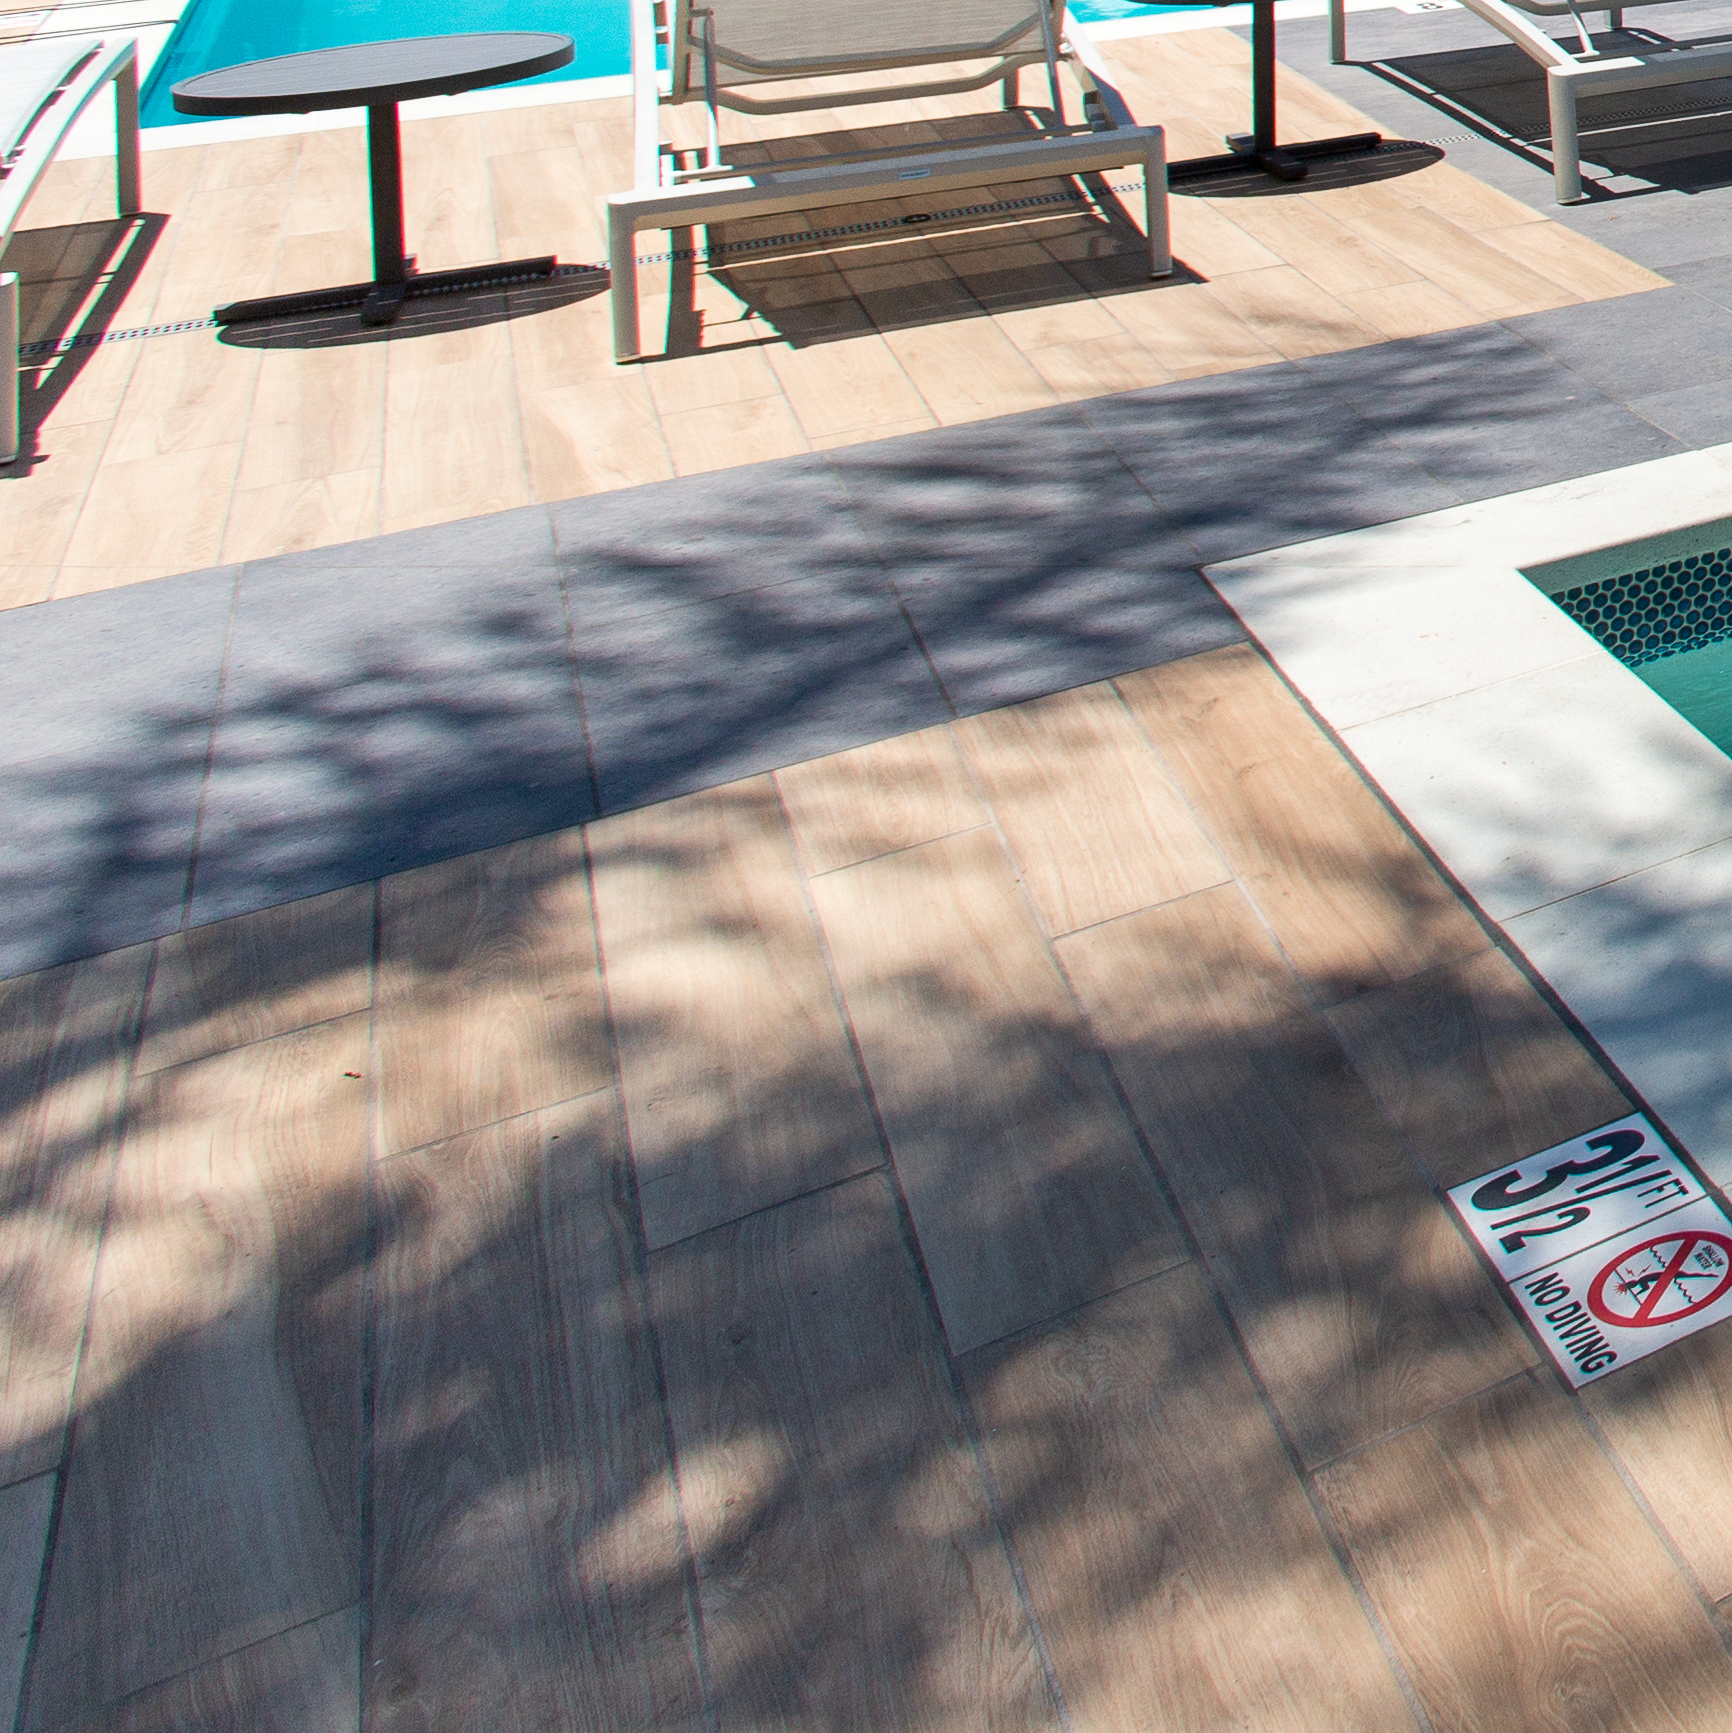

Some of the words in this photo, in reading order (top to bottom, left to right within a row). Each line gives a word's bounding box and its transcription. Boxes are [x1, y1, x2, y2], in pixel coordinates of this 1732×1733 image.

[1638, 1176, 1691, 1208] FT
[1524, 1272, 1571, 1306] NO
[1544, 1299, 1617, 1374] DIVING
